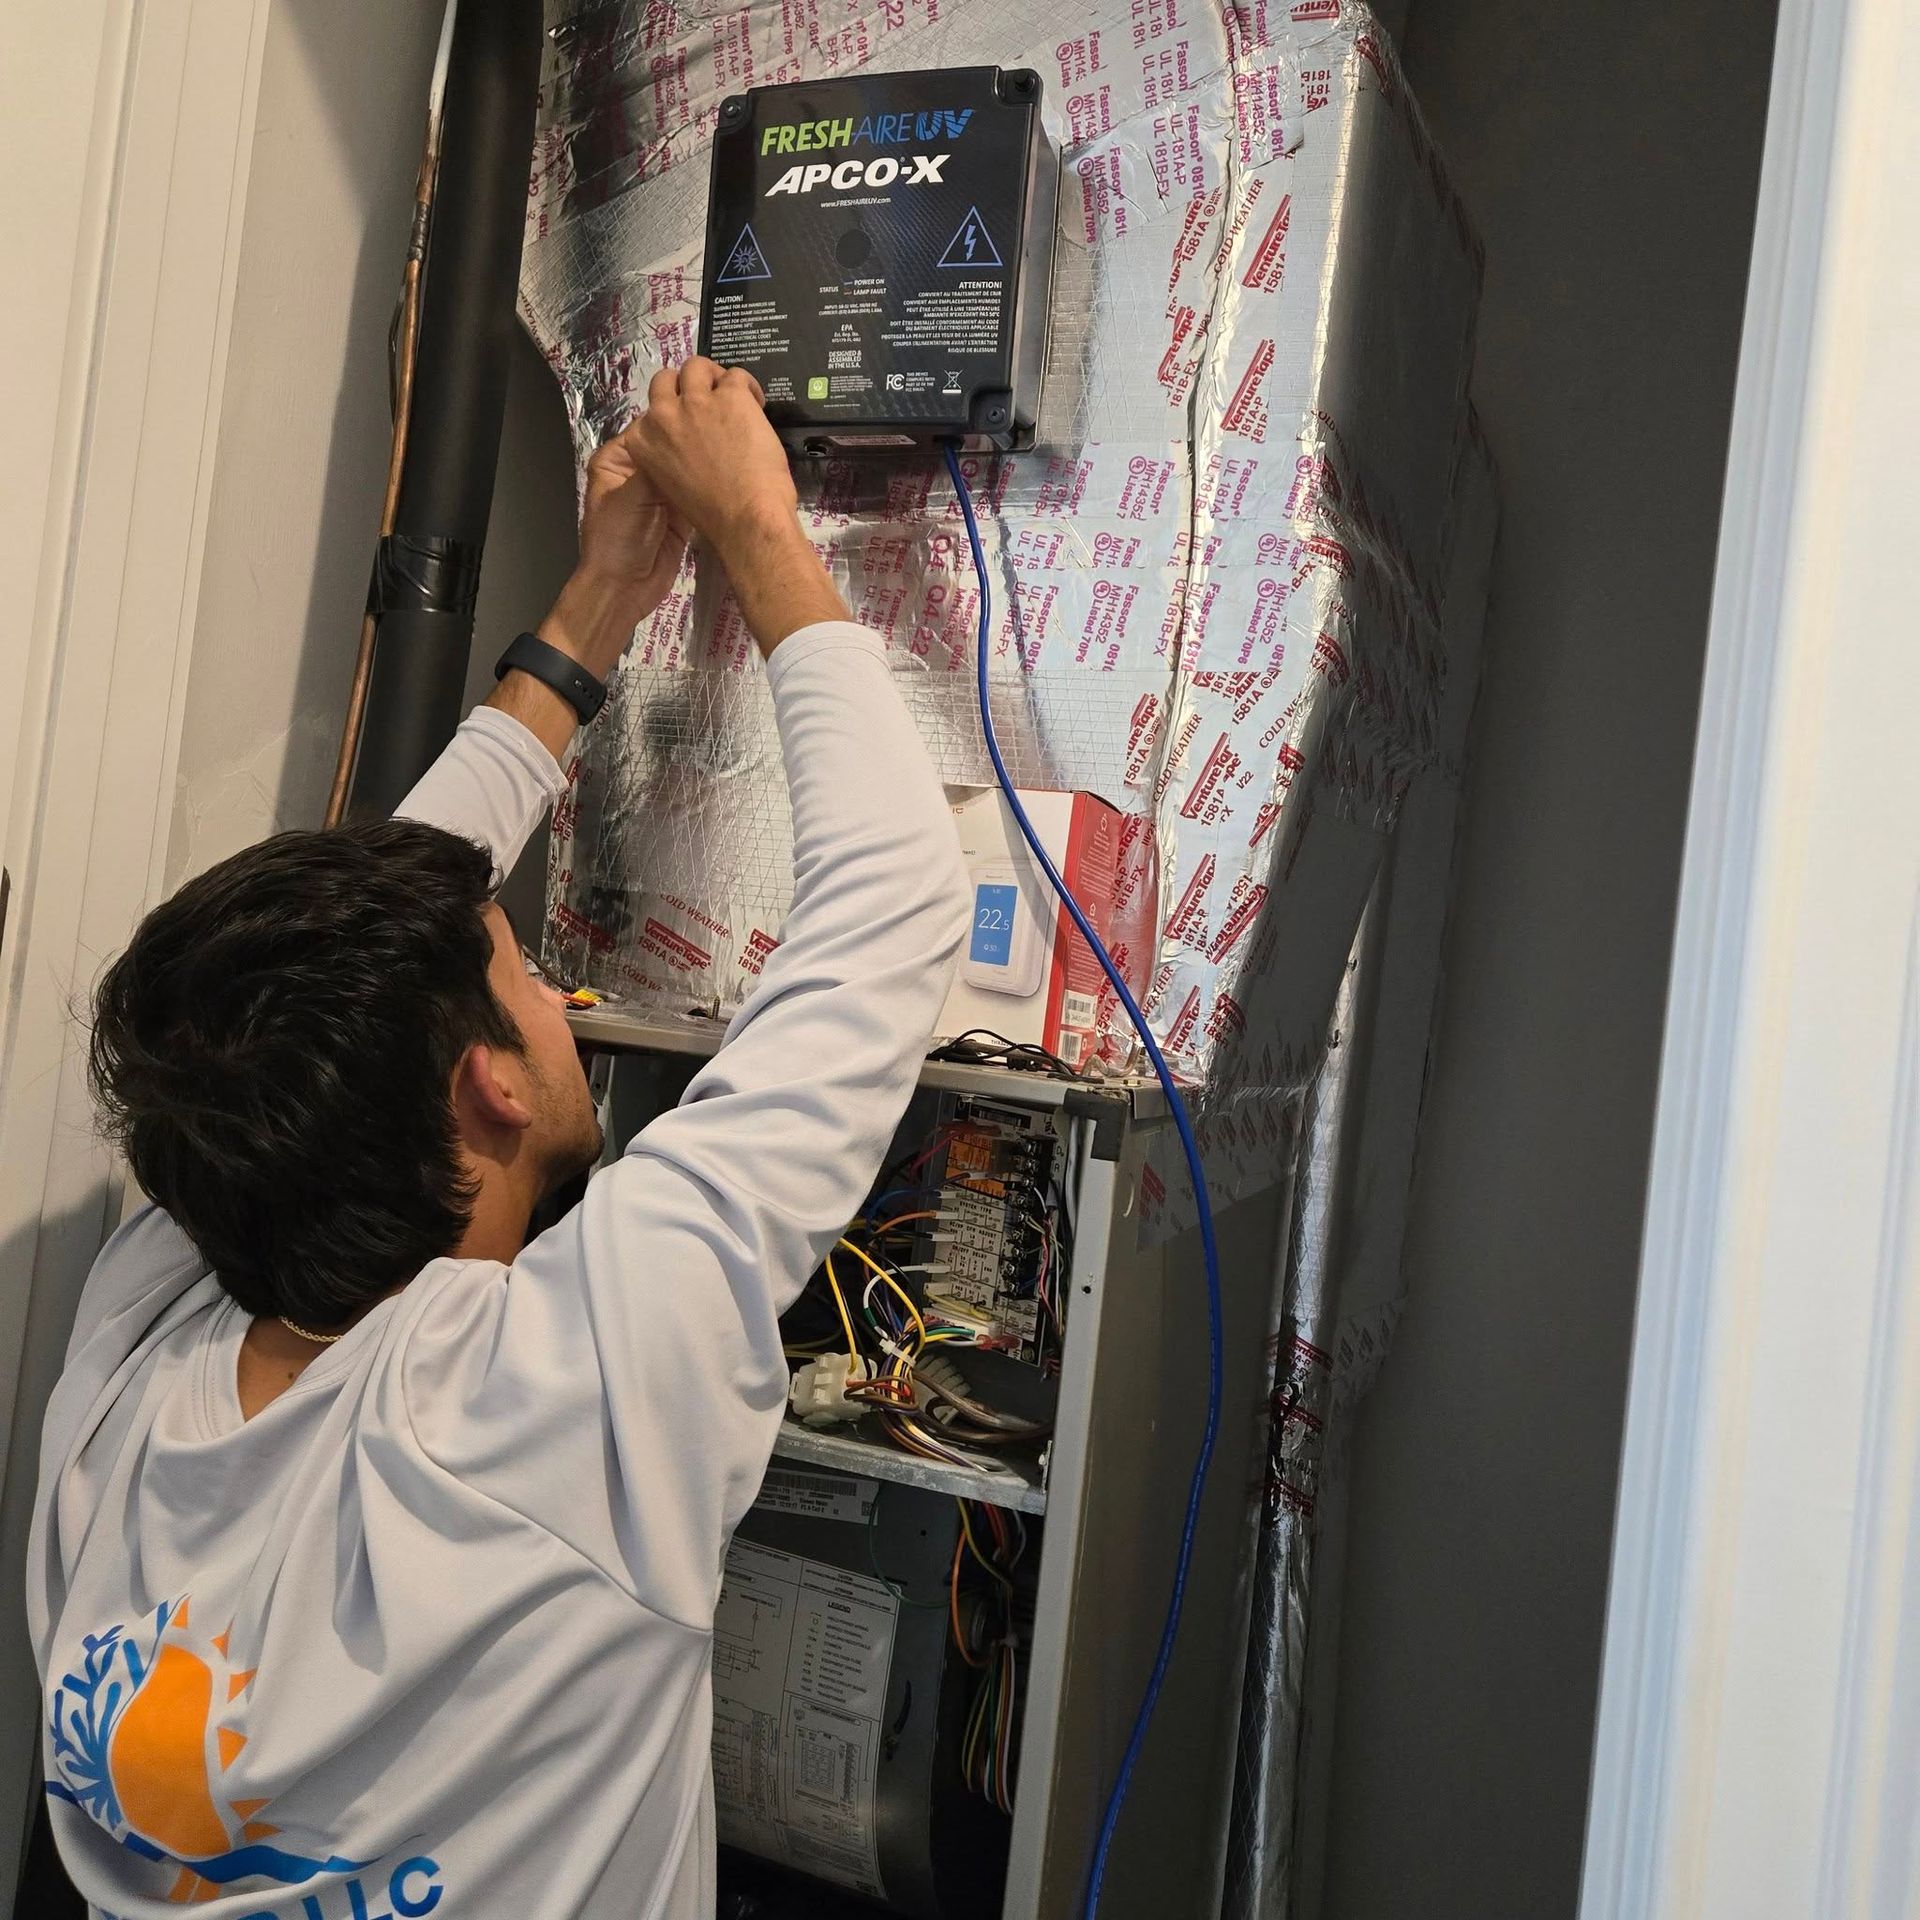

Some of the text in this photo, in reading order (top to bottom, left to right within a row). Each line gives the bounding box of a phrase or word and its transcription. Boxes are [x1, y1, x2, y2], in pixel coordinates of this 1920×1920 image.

[712, 19, 726, 89] UL 181B-FX
[726, 15, 739, 77] UL 181A-P
[1142, 55, 1154, 75] UL
[1159, 50, 1172, 69] UL
[1153, 118, 1170, 200] UL 181B-FX
[1170, 113, 1186, 186] UL 181A-P
[1094, 154, 1110, 216] MH14352
[1078, 177, 1096, 244] Listed 70P6
[1214, 178, 1264, 273] COLD WEATHER
[1182, 221, 1210, 262] 1581A
[715, 295, 743, 304] CAUTION!
[1170, 358, 1200, 407] 181B-FX
[1238, 396, 1265, 438] 181A-P
[1065, 460, 1078, 477] UL
[1205, 454, 1223, 474] UL
[1223, 460, 1241, 477] UL
[1118, 475, 1139, 511] Listed
[1130, 460, 1159, 521] MH14352
[870, 536, 882, 551] UL
[1018, 530, 1033, 547] UL
[1035, 534, 1047, 551] UL
[1175, 532, 1189, 550] UL
[864, 585, 877, 600] UL
[878, 589, 891, 604] UL
[1030, 585, 1043, 602] UL
[650, 605, 666, 640] Listed
[659, 593, 682, 647] MH14352
[910, 584, 948, 657] Q4-22
[940, 588, 968, 645] MH14352
[995, 580, 1028, 657] UL 181B-FX
[1075, 599, 1103, 663] Listed 70P6
[1095, 584, 1123, 644] MH14352
[1153, 578, 1188, 657] UL 181B-FX
[1237, 597, 1269, 665] Listed 70P6
[1259, 583, 1290, 645] MH14352
[1232, 690, 1264, 726] 1581A
[1168, 713, 1202, 769] WEATHER
[1258, 718, 1287, 749] COLD
[1123, 748, 1149, 787] 1581A
[1114, 865, 1144, 910] 181B-FX
[687, 905, 729, 938] WEATHER
[637, 935, 667, 962] 1581A
[622, 965, 648, 986] COLD
[1142, 965, 1174, 1019] WEATHER
[828, 1601, 851, 1613] LEGEND
